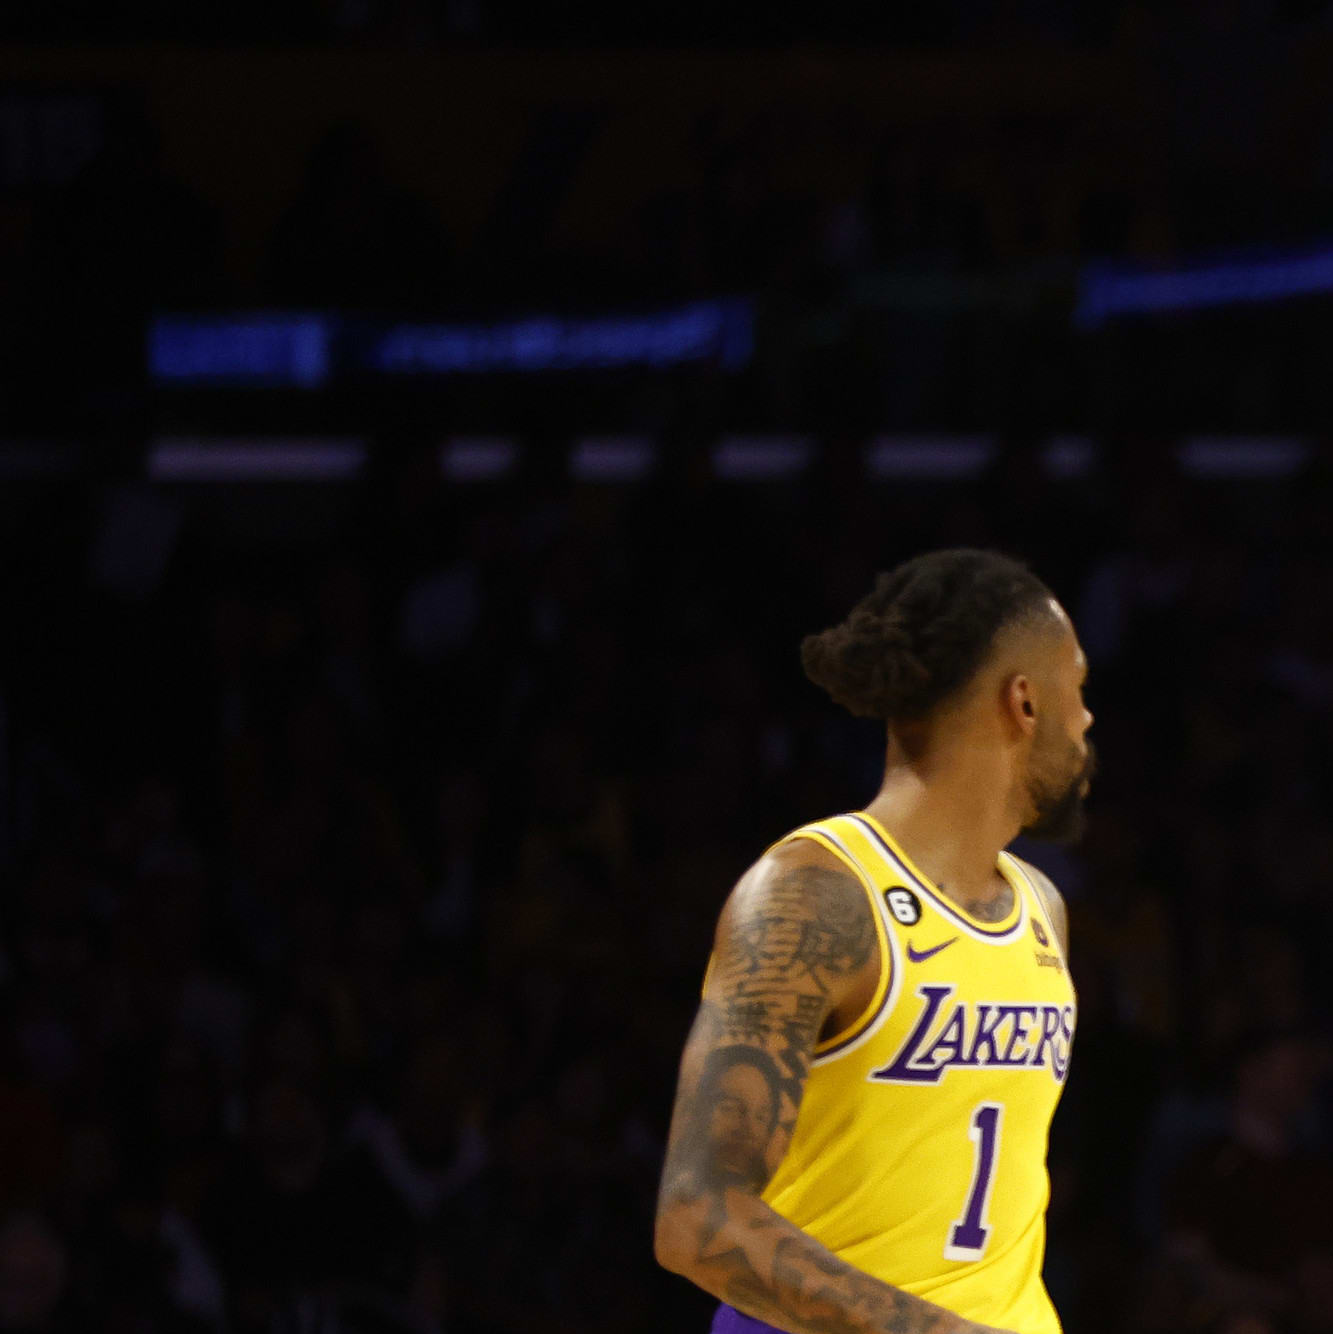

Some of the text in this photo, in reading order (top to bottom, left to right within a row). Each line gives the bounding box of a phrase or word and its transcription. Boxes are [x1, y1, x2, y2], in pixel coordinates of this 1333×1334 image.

[886, 887, 919, 925] 6
[867, 983, 1075, 1084] LAKERS
[945, 1103, 1003, 1259] 1
